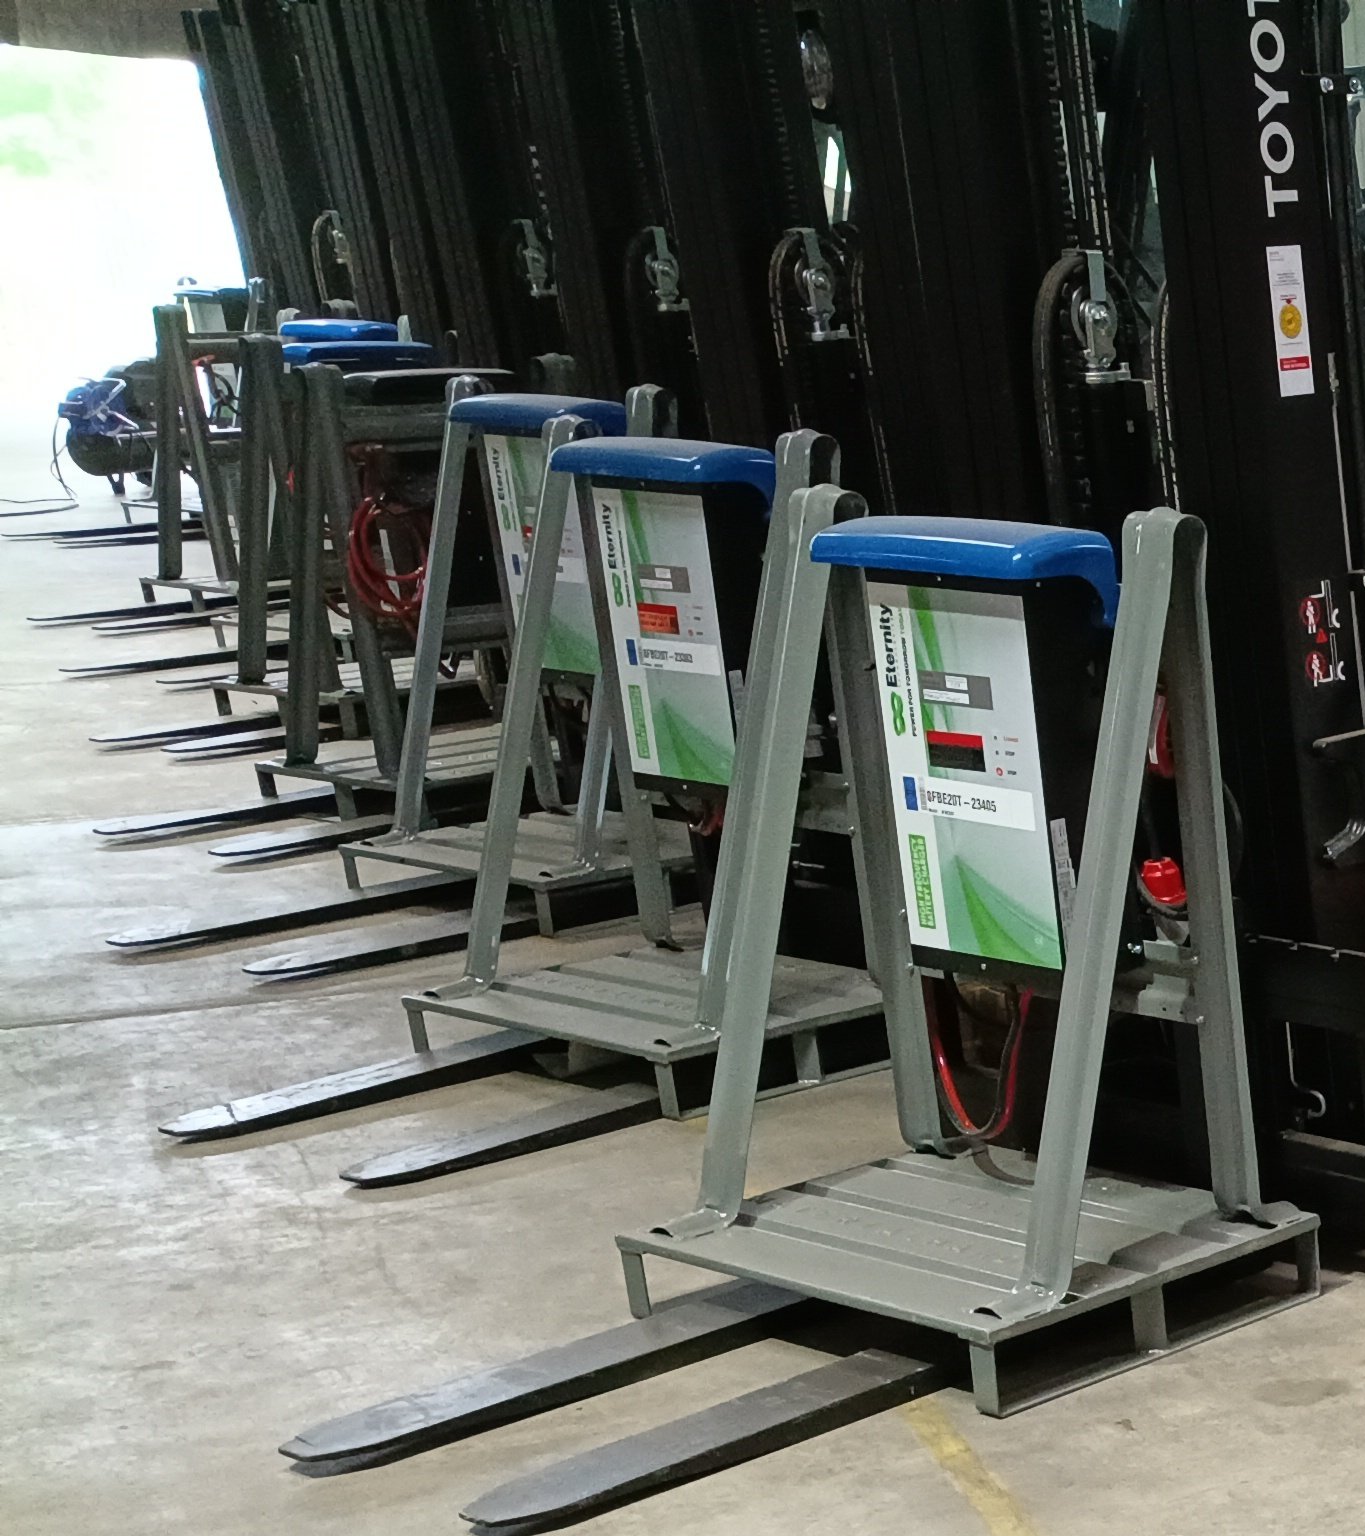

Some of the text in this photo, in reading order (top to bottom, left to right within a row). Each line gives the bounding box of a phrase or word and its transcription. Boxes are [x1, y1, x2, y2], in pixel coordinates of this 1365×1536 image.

[491, 448, 506, 501] Eternity
[602, 503, 618, 569] Eternity
[879, 603, 898, 687] Eternity
